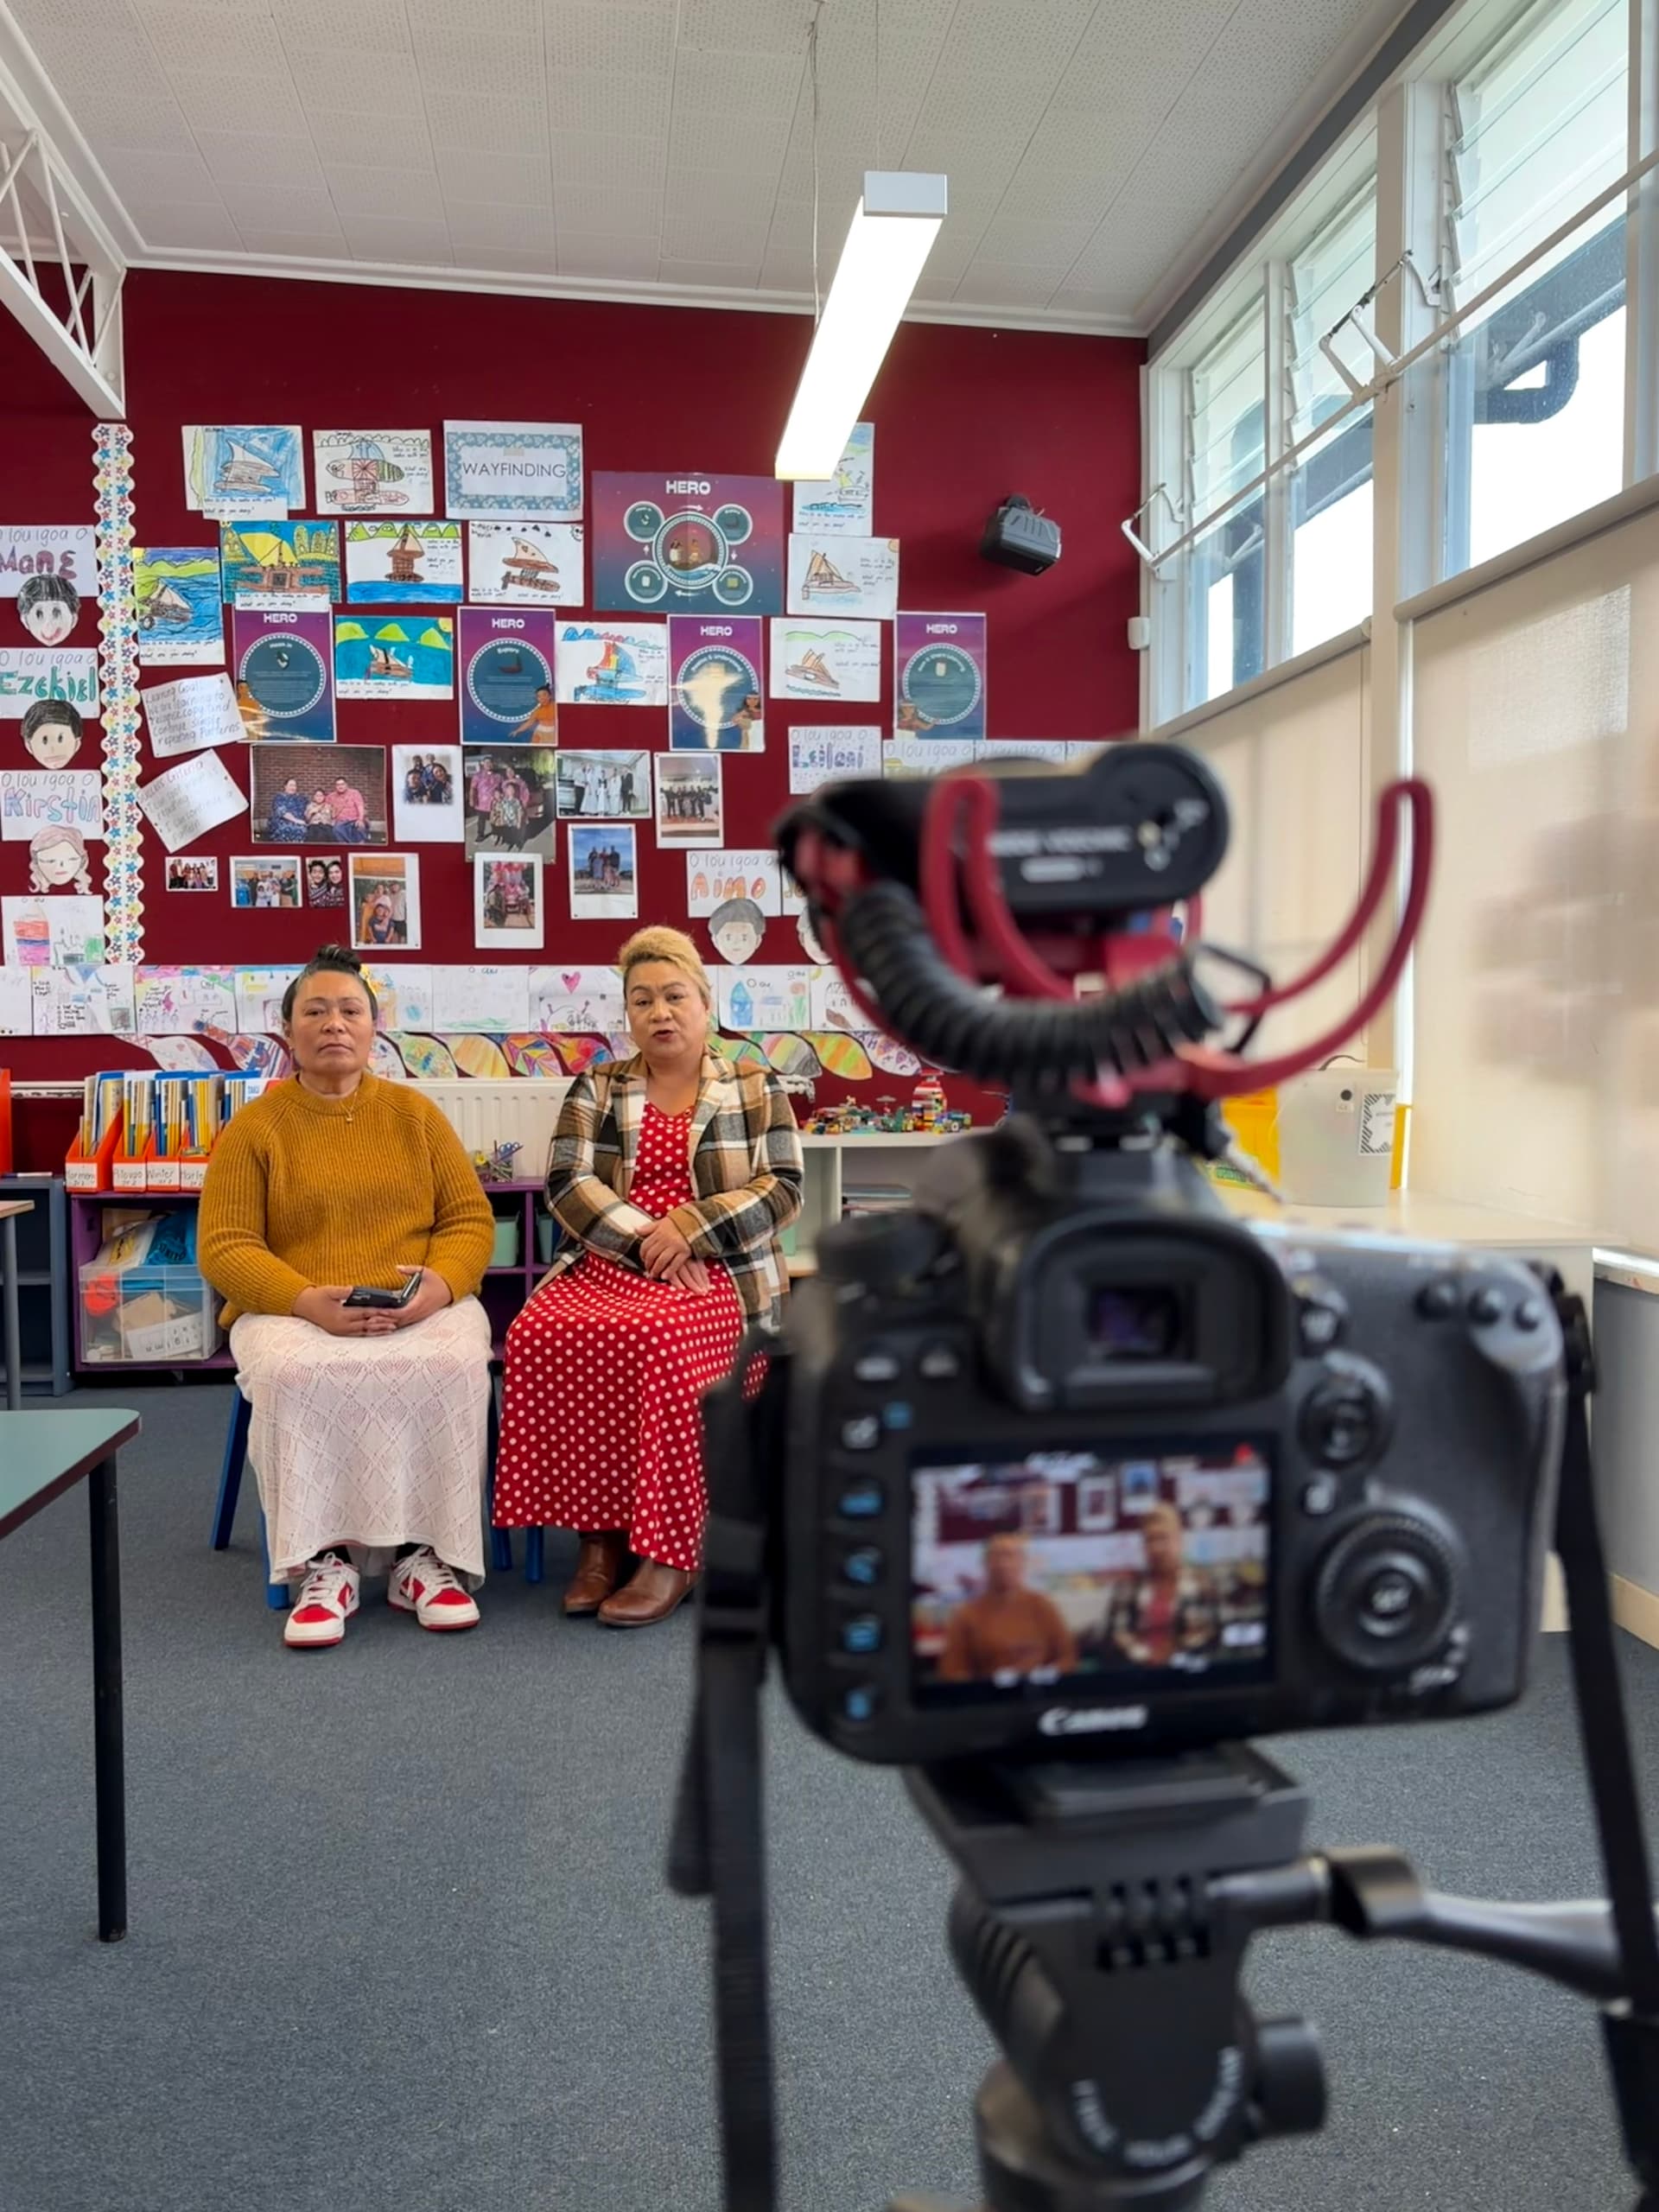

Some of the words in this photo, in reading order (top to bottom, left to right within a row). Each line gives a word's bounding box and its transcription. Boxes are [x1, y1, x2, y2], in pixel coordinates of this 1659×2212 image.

[463, 462, 566, 478] WAYFINDING
[665, 480, 711, 495] HERO
[264, 613, 298, 623] HERO
[492, 618, 525, 629] HERO
[701, 626, 733, 636] HERO
[926, 624, 957, 634] HERO
[4, 785, 102, 823] Kirstin
